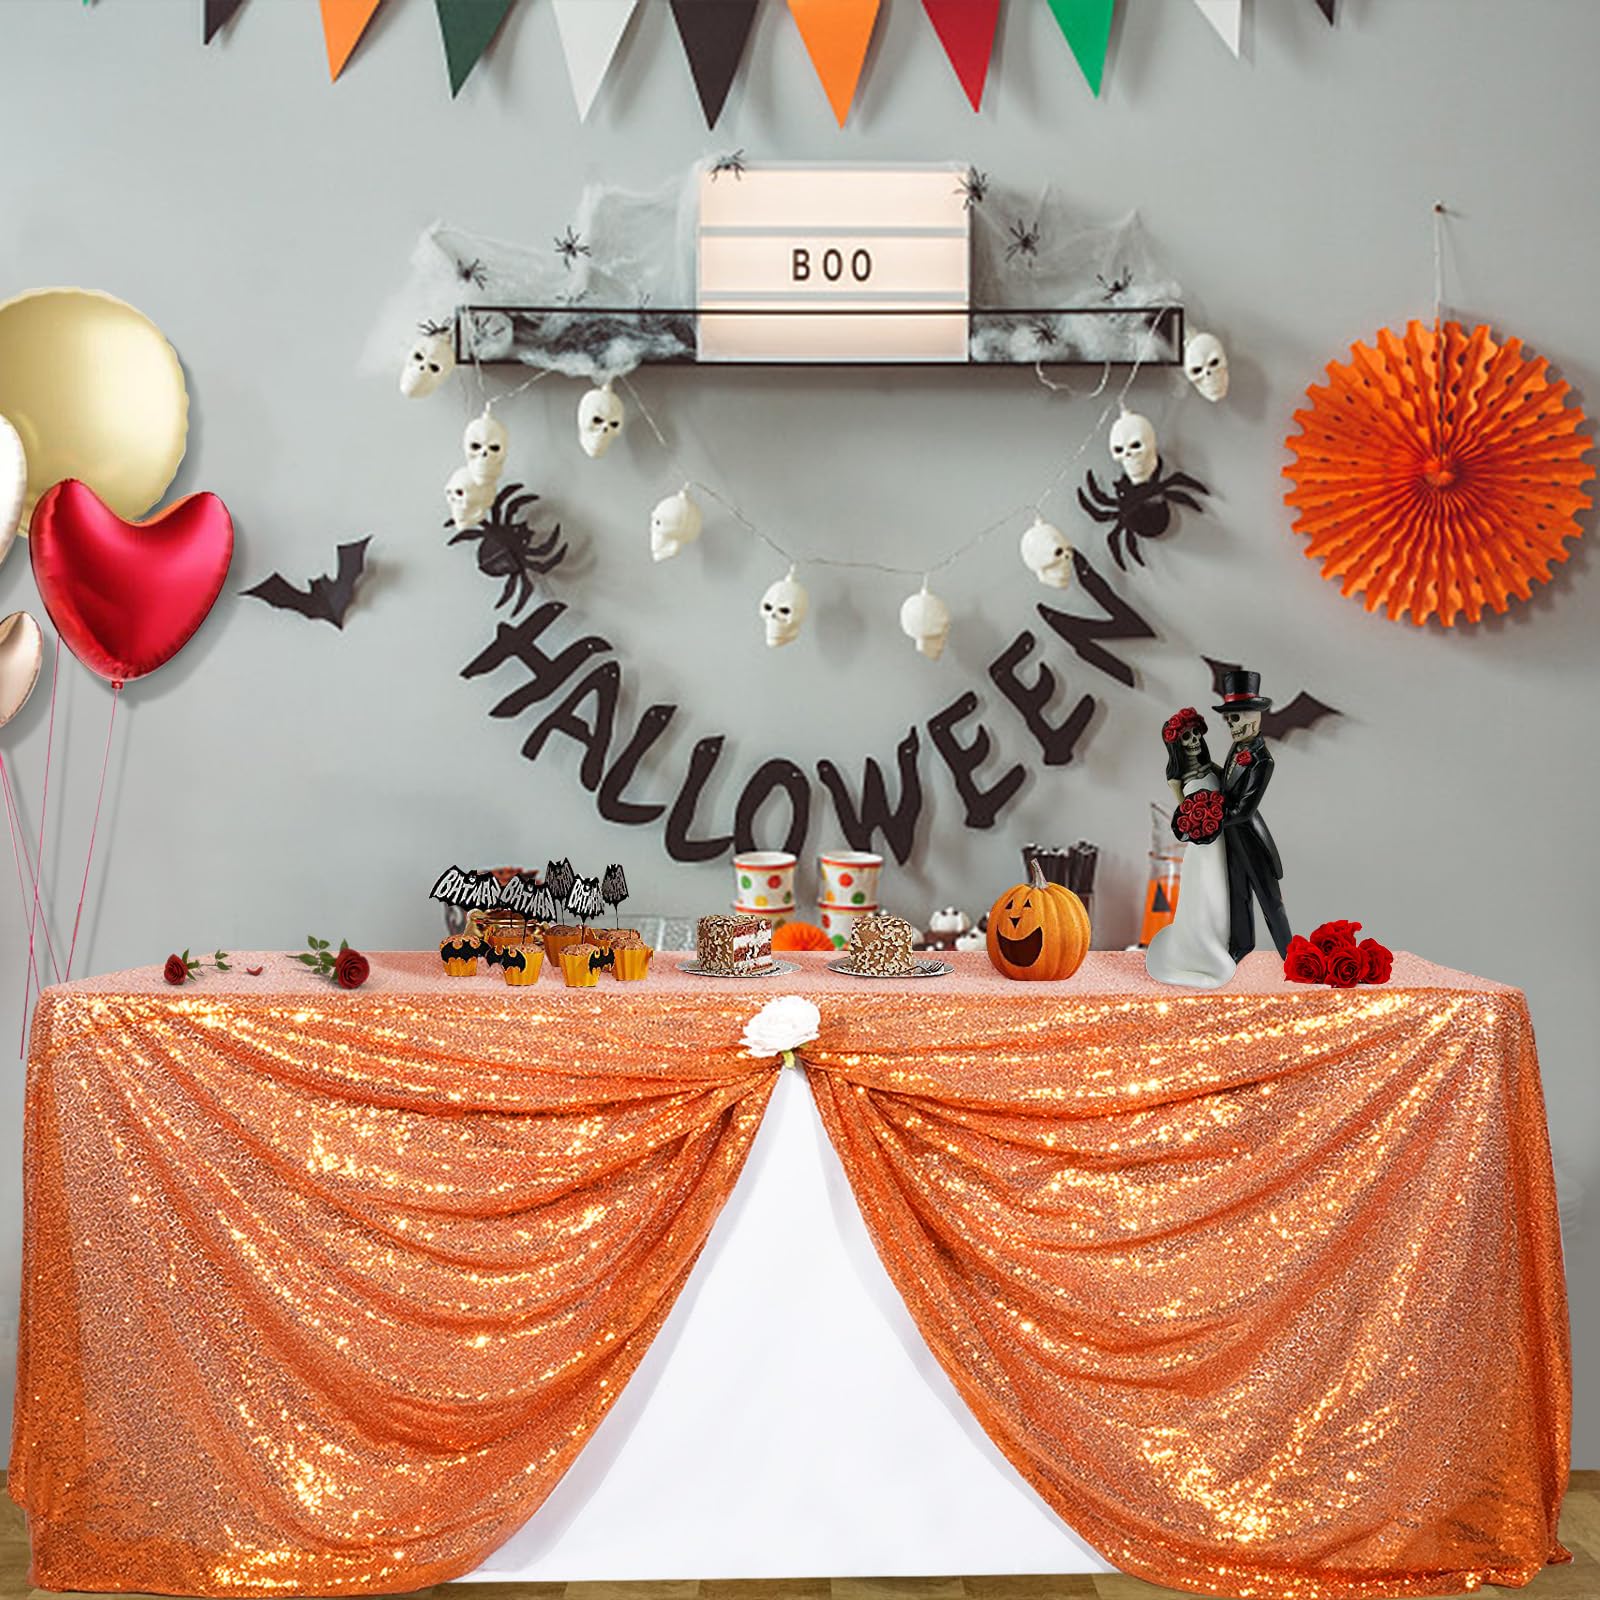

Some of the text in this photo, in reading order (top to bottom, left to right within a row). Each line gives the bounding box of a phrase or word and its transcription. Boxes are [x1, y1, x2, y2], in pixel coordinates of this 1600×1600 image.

[792, 249, 872, 282] BOO
[460, 547, 1156, 865] HALLOWEEN
[433, 869, 501, 908] BATMAN
[500, 875, 556, 919] BATMAN
